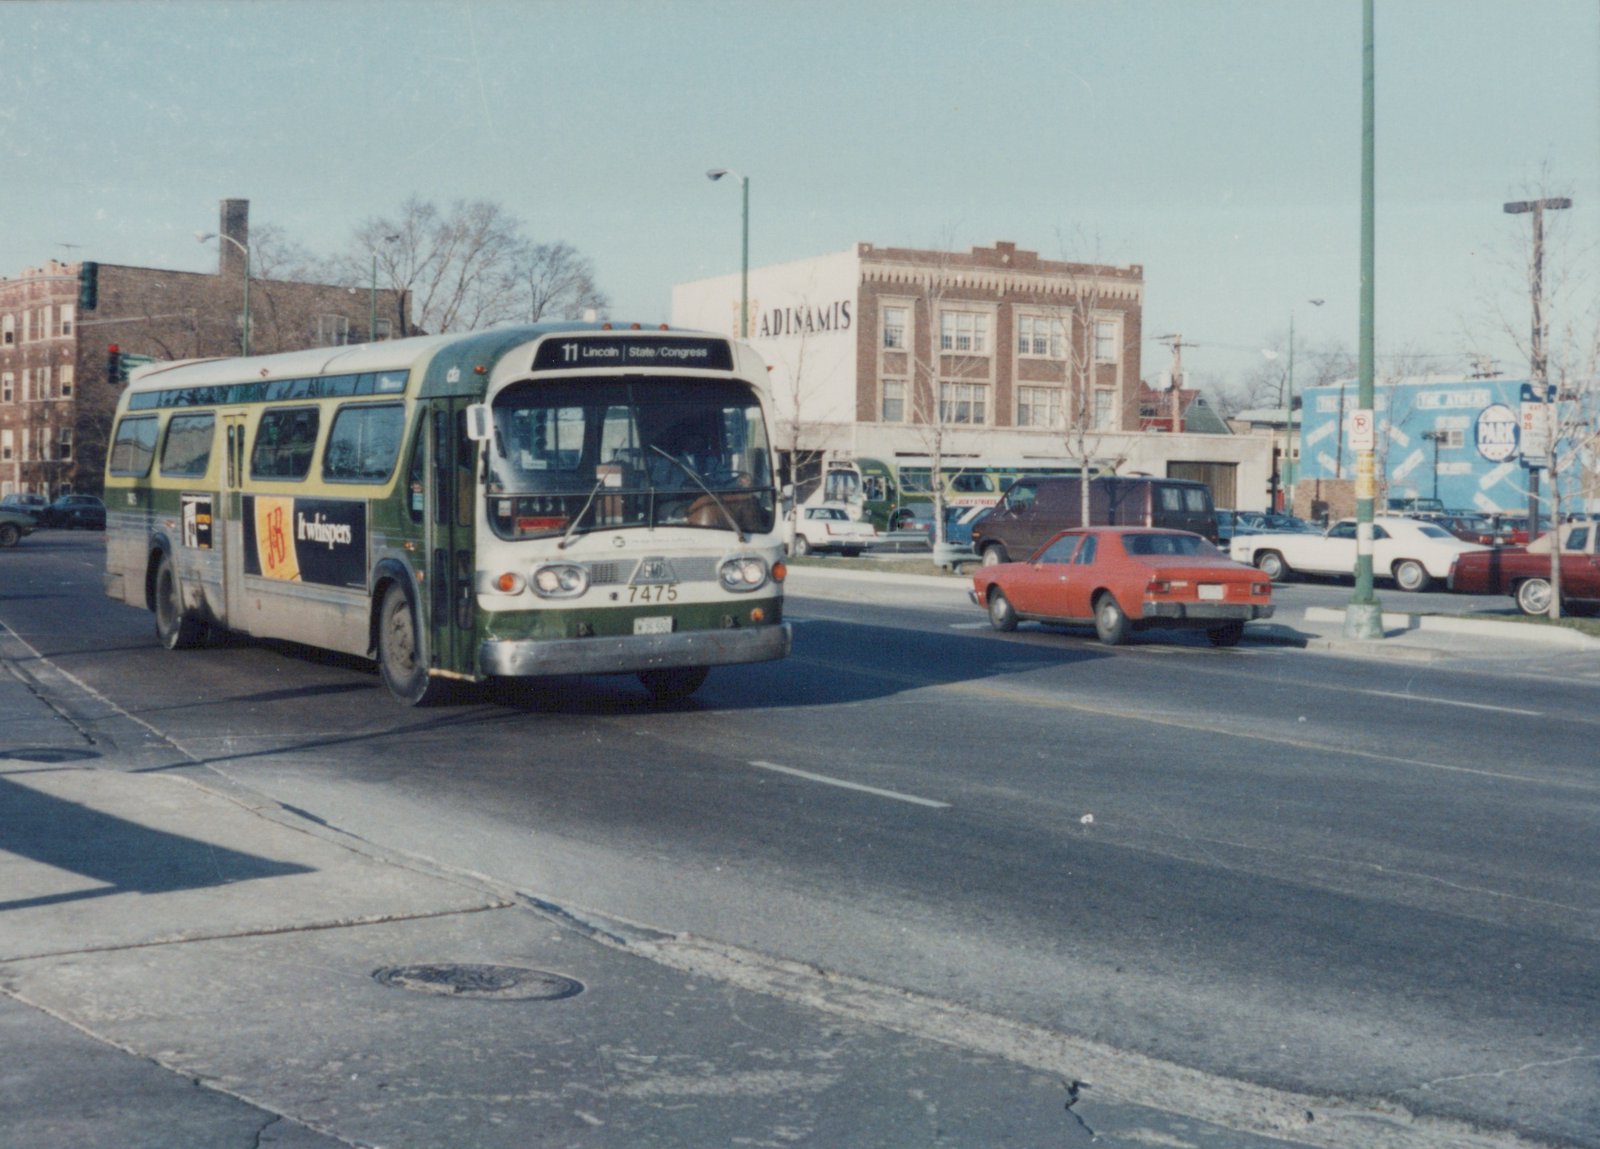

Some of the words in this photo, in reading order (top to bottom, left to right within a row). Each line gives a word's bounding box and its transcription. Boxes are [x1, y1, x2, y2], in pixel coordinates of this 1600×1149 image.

[759, 300, 851, 338] ADINAMIS
[562, 343, 578, 361] 11
[582, 346, 619, 357] Lincoln
[1478, 421, 1518, 444] PARK
[297, 512, 306, 540] It
[306, 513, 352, 549] whispers
[628, 584, 678, 603] 7475
